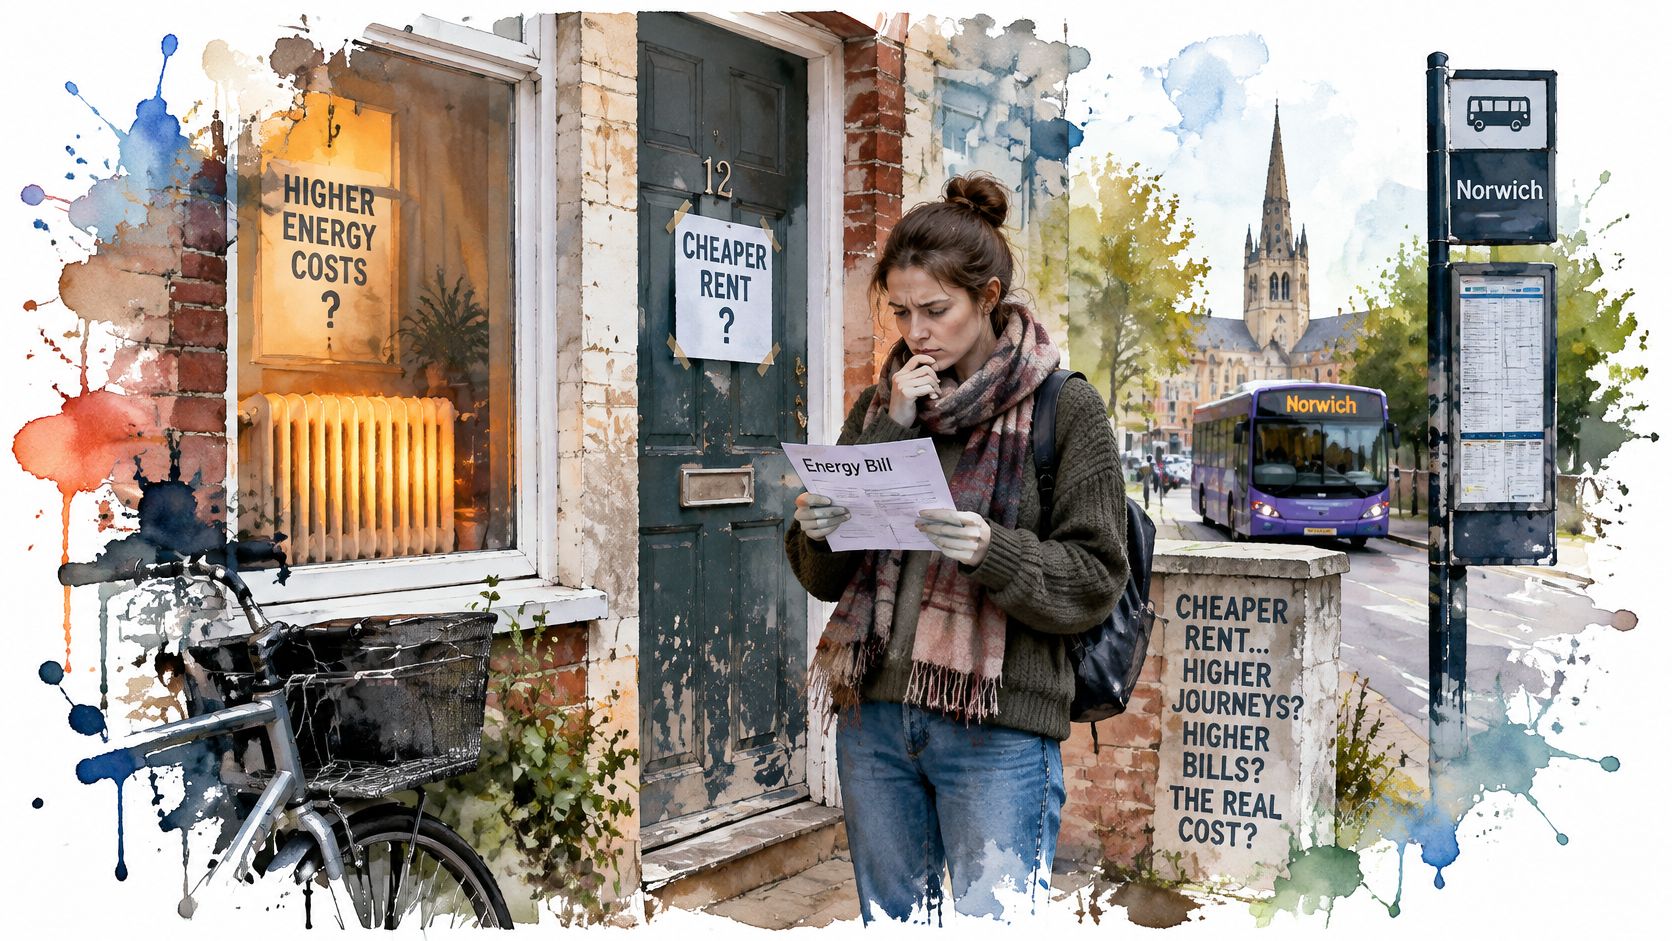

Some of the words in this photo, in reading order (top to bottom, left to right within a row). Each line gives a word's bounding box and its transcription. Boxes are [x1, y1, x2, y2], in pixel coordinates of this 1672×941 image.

[703, 156, 733, 198] 12
[1456, 179, 1544, 200] Norwich
[284, 174, 375, 216] HIGHER
[283, 211, 377, 251] ENERGY
[682, 231, 767, 270] CHEAPER
[291, 250, 368, 287] COSTS
[700, 269, 752, 302] RENT
[321, 290, 341, 329] ?
[718, 306, 735, 344] ?
[1285, 394, 1357, 414] Norwich
[802, 458, 861, 477] Energy
[864, 457, 893, 473] Bill
[1175, 593, 1288, 624] CHEAPER
[1185, 625, 1270, 655] RENT...
[1183, 658, 1272, 688] HIGHER
[1171, 688, 1305, 721] JOURNEYS?
[1182, 721, 1270, 752] HIGHER
[1182, 752, 1265, 784] BILLS?
[1169, 785, 1214, 814] THE
[1222, 789, 1283, 821] REAL
[1178, 816, 1258, 850] COST?
